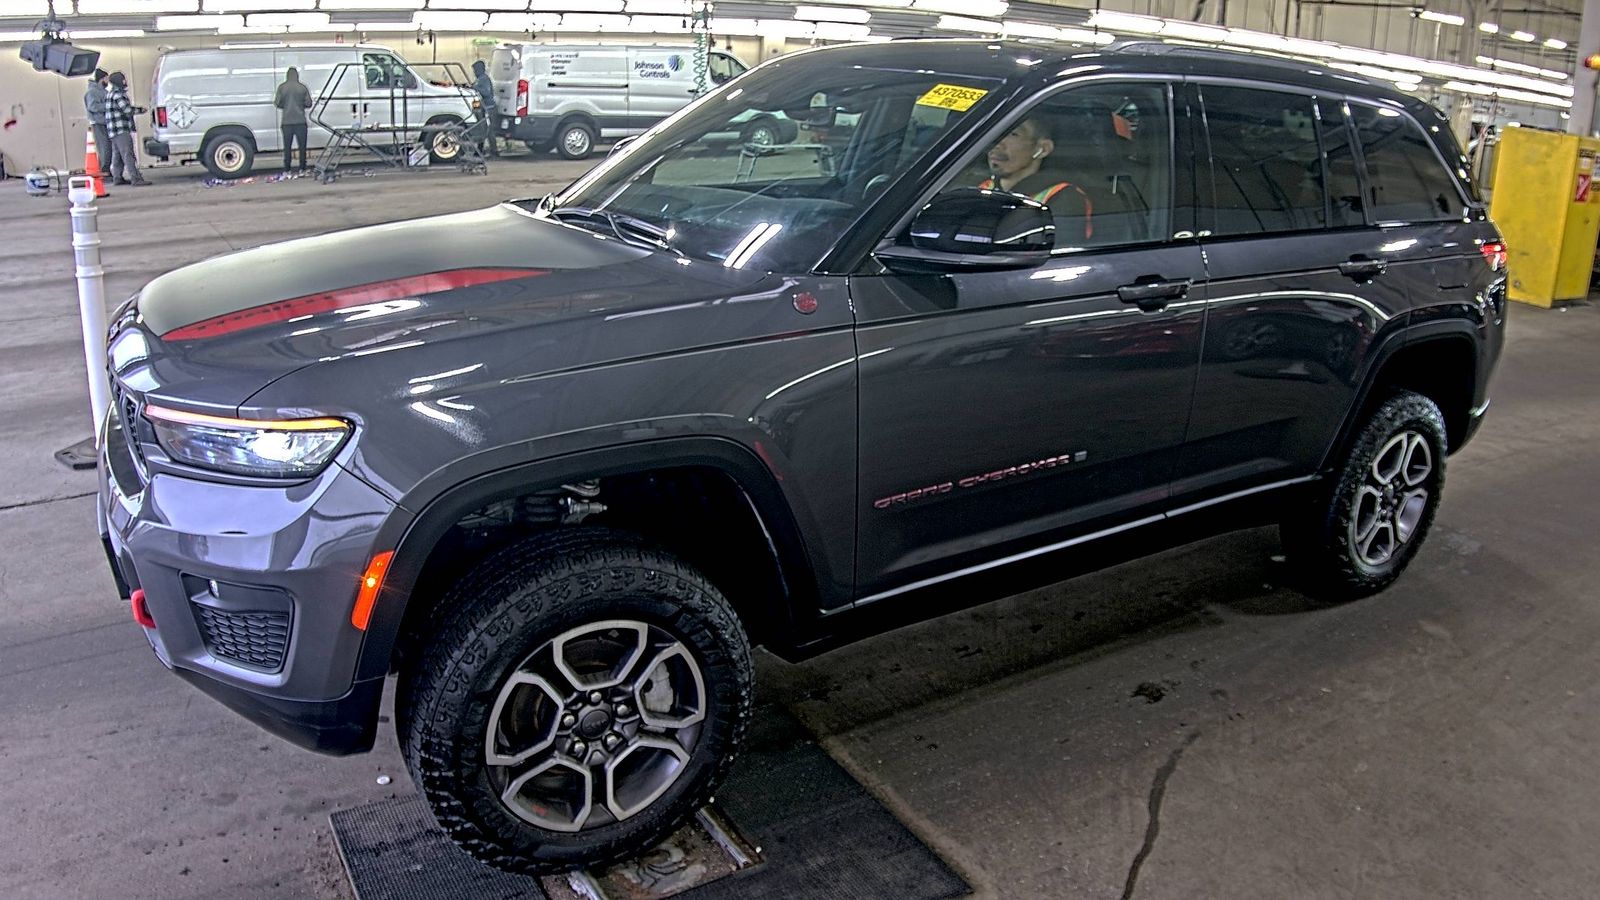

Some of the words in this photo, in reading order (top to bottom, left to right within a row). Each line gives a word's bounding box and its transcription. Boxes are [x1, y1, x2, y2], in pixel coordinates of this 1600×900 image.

[634, 61, 664, 70] Johnson
[640, 70, 670, 79] Controls
[932, 86, 984, 101] 4370533
[874, 482, 953, 508] GRAND
[958, 454, 1069, 488] CHEROKEE
